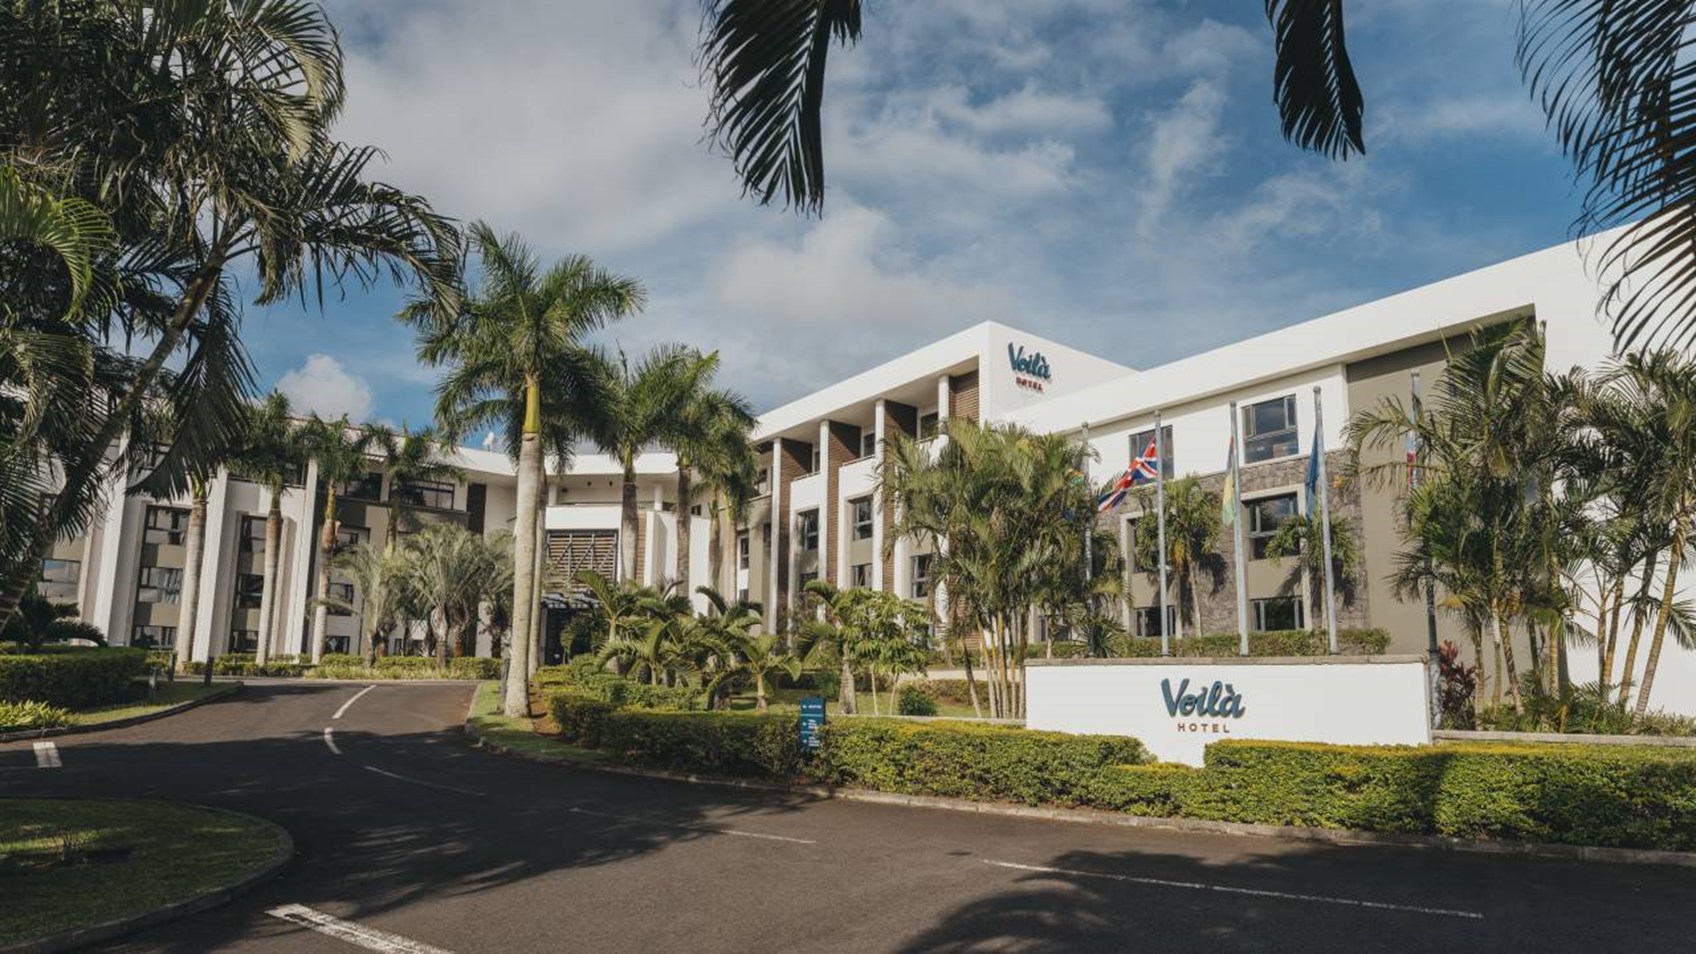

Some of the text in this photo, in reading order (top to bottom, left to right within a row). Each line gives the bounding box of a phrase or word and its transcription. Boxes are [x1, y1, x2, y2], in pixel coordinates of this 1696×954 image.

[1008, 342, 1051, 380] Voilà
[1016, 376, 1042, 391] HOTEL
[1161, 678, 1246, 719] Voilà
[1177, 723, 1230, 734] HOTEL
